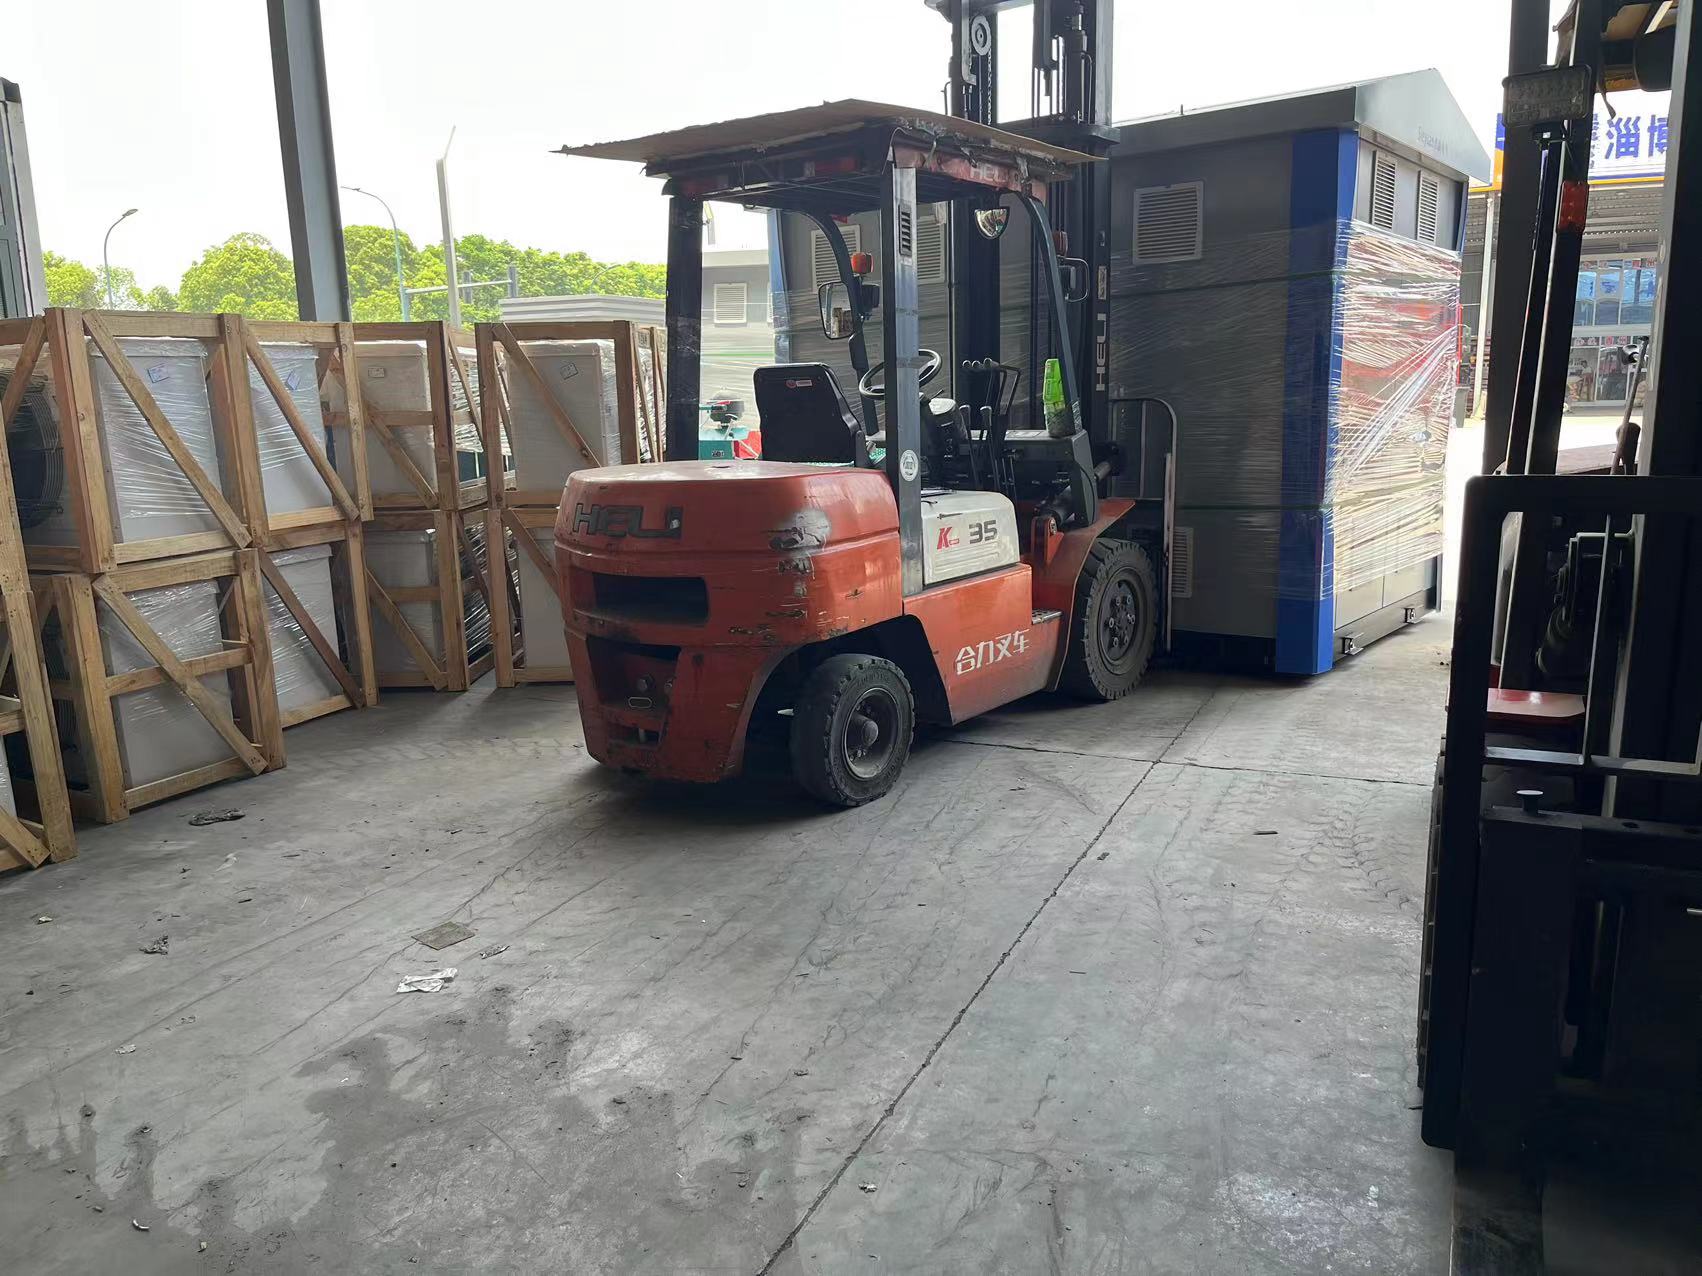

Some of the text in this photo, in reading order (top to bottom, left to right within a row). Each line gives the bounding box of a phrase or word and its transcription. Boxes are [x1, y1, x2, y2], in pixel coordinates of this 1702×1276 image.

[1096, 313, 1107, 391] HELI
[572, 503, 683, 539] HELI
[937, 519, 998, 550] K 35
[955, 628, 1031, 675] 合力叉车
